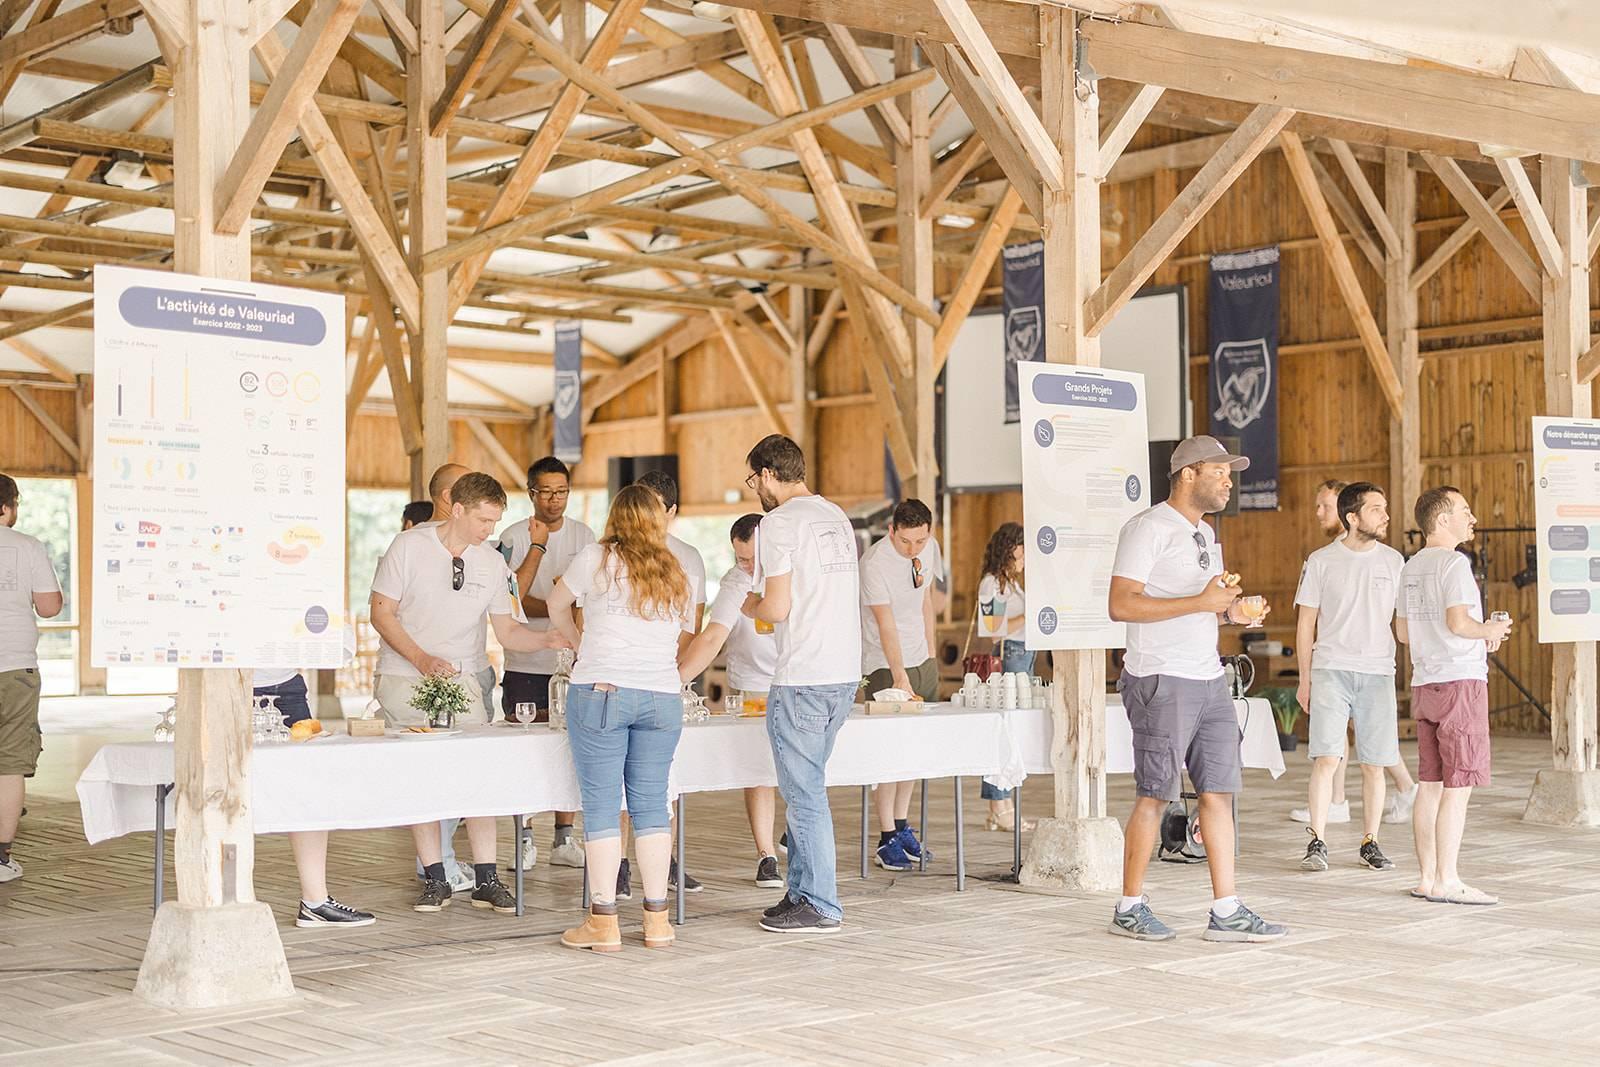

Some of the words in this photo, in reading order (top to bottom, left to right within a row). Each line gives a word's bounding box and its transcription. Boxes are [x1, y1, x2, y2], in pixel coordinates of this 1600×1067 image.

[157, 296, 216, 315] L'activité
[219, 304, 235, 318] de
[237, 305, 294, 325] Valeuriad
[193, 317, 223, 328] Exercice
[224, 321, 242, 330] 2022
[246, 323, 263, 333] 2023
[1064, 381, 1090, 393] Grands
[1091, 384, 1113, 397] Projets
